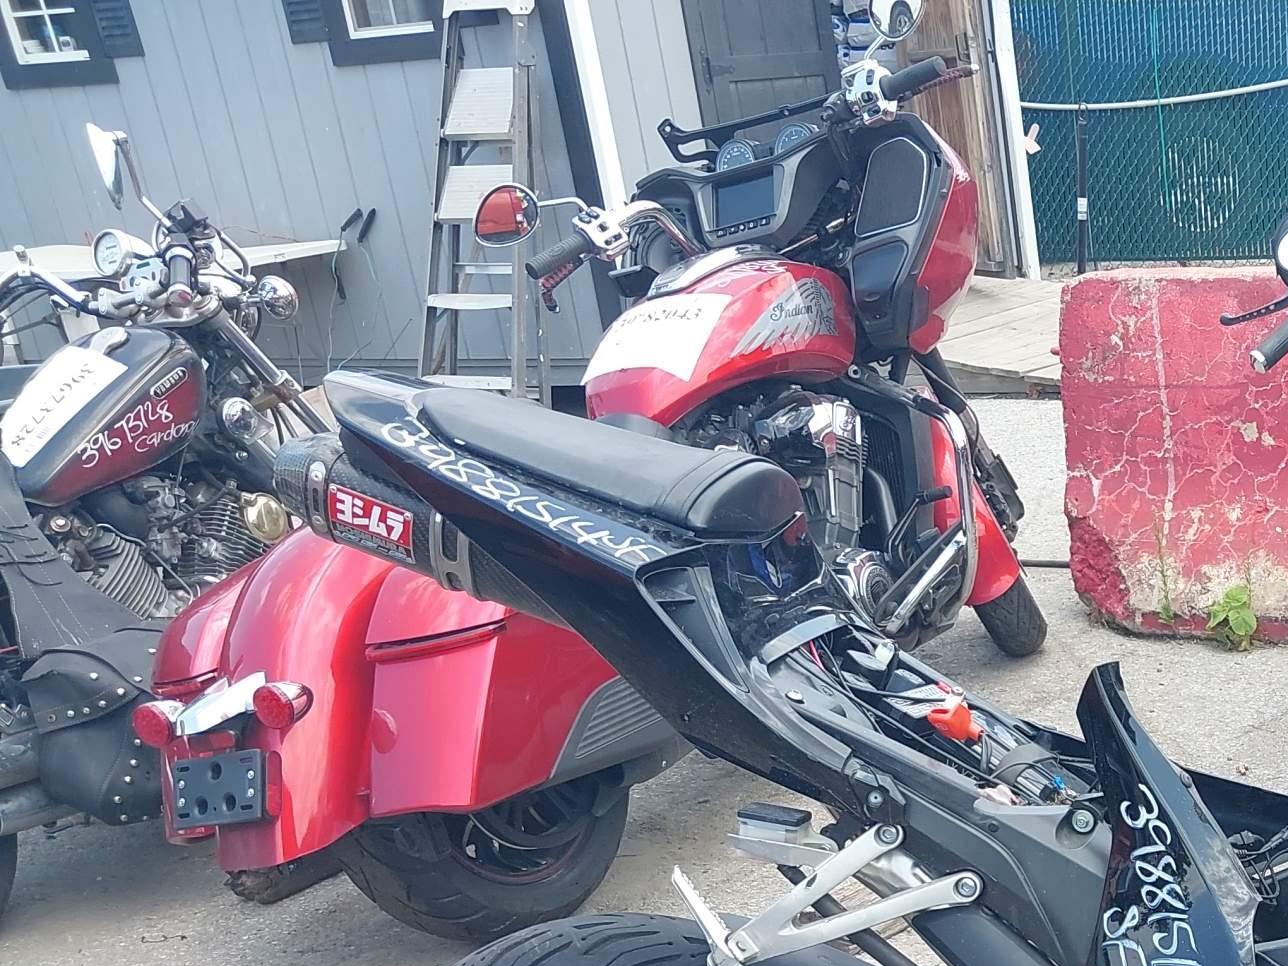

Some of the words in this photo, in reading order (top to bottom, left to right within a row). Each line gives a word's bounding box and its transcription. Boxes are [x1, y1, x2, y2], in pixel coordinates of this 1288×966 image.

[769, 303, 815, 322] Indian
[336, 491, 405, 541] ヨシムラ
